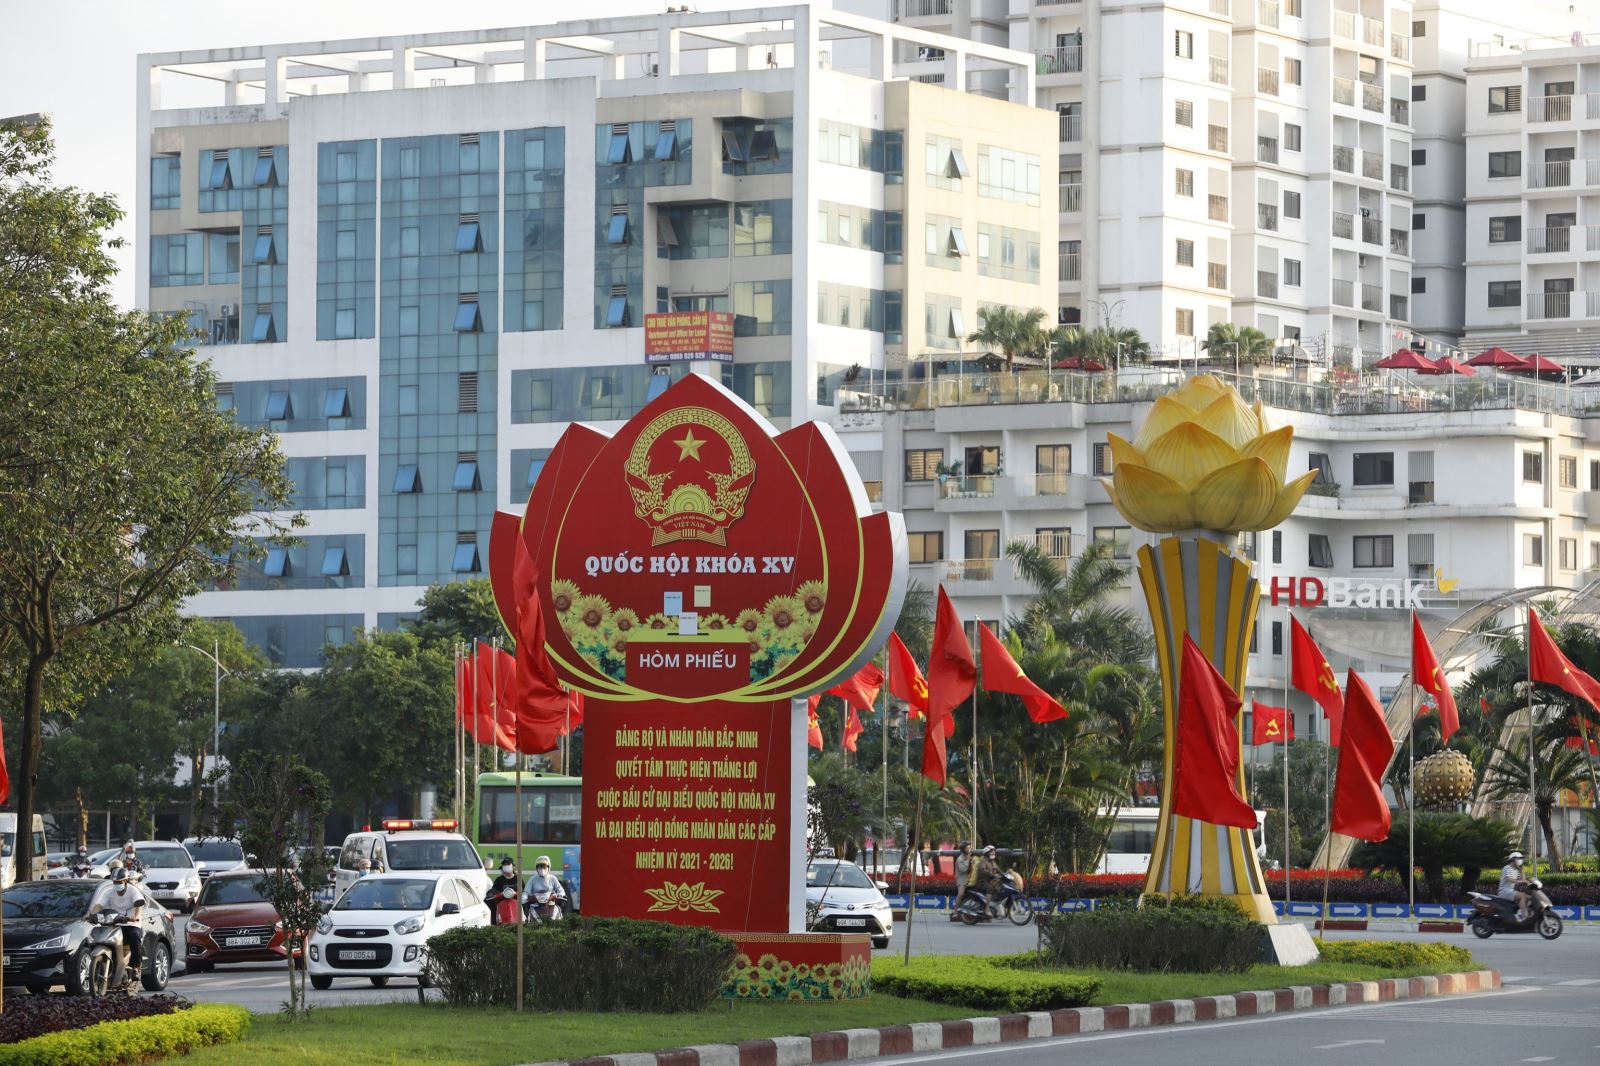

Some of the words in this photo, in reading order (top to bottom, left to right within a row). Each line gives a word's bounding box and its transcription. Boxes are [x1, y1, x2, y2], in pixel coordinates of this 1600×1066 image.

[673, 521, 689, 529] VIỆT
[690, 521, 706, 529] NAM
[585, 550, 643, 577] QUỐC
[650, 552, 690, 577] HỘI
[695, 552, 757, 574] KHÓA
[762, 556, 794, 574] XV
[1270, 576, 1425, 609] HDBank
[639, 650, 680, 668] HÒM
[685, 648, 737, 668] PHIẾU
[615, 724, 640, 747] ĐẢNG
[642, 726, 653, 750] BỘ
[656, 726, 667, 747] VÀ
[669, 726, 694, 748] NHÂN
[696, 727, 714, 748] DÂN
[717, 724, 734, 749] BẮC
[736, 731, 758, 748] NINH
[615, 755, 643, 779] QUYẾT
[645, 757, 664, 778] TÂM
[666, 759, 688, 781] THỰC
[690, 757, 711, 781] HIỆN
[713, 755, 742, 779] THẮNG
[744, 760, 757, 782] LỢI
[597, 787, 621, 811] CUỘC
[623, 785, 640, 808] BẦU
[643, 785, 655, 808] CỬ
[656, 790, 671, 811] ĐẠI
[673, 784, 693, 808] BIỂU
[696, 785, 718, 810] QUỐC
[721, 788, 736, 812] HỘI
[738, 789, 761, 810] KHÓA
[764, 793, 776, 810] XV
[595, 818, 607, 839] VÀ
[608, 821, 623, 842] ĐẠI
[626, 814, 645, 839] BIỂU
[648, 818, 662, 842] HỘI
[664, 816, 688, 839] ĐỒNG
[690, 819, 715, 840] NHÂN
[718, 819, 736, 840] DÂN
[738, 820, 756, 841] CÁC
[758, 818, 776, 841] CẤP
[635, 848, 665, 872] NHIỆM
[666, 849, 678, 869] KỲ
[680, 853, 700, 870] 2021
[709, 852, 734, 870] 2026!
